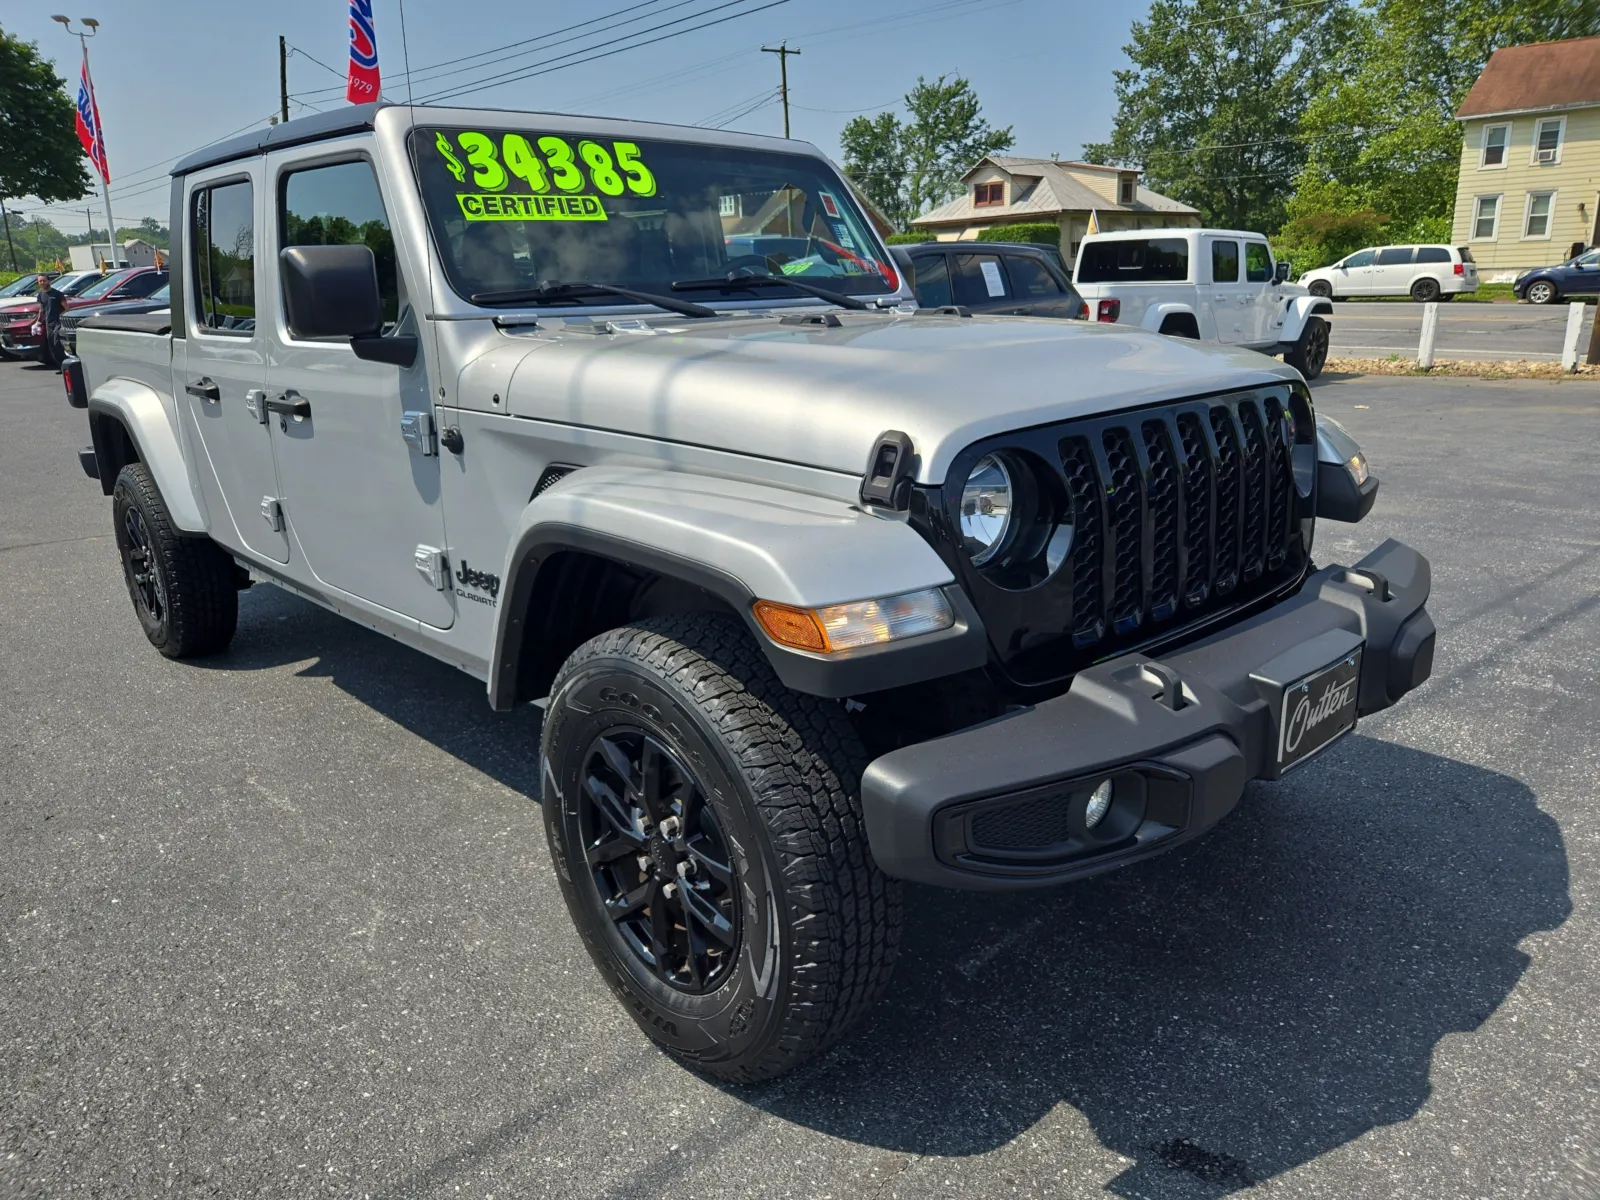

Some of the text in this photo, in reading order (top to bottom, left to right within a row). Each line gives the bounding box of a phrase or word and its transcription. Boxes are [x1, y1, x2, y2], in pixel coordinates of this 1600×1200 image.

[348, 75, 373, 94] 1979
[435, 131, 657, 198] $34385
[461, 196, 602, 217] CERTIFIED
[455, 559, 501, 599] Jeep
[456, 588, 498, 608] GLADIATO
[1285, 676, 1357, 753] Outten
